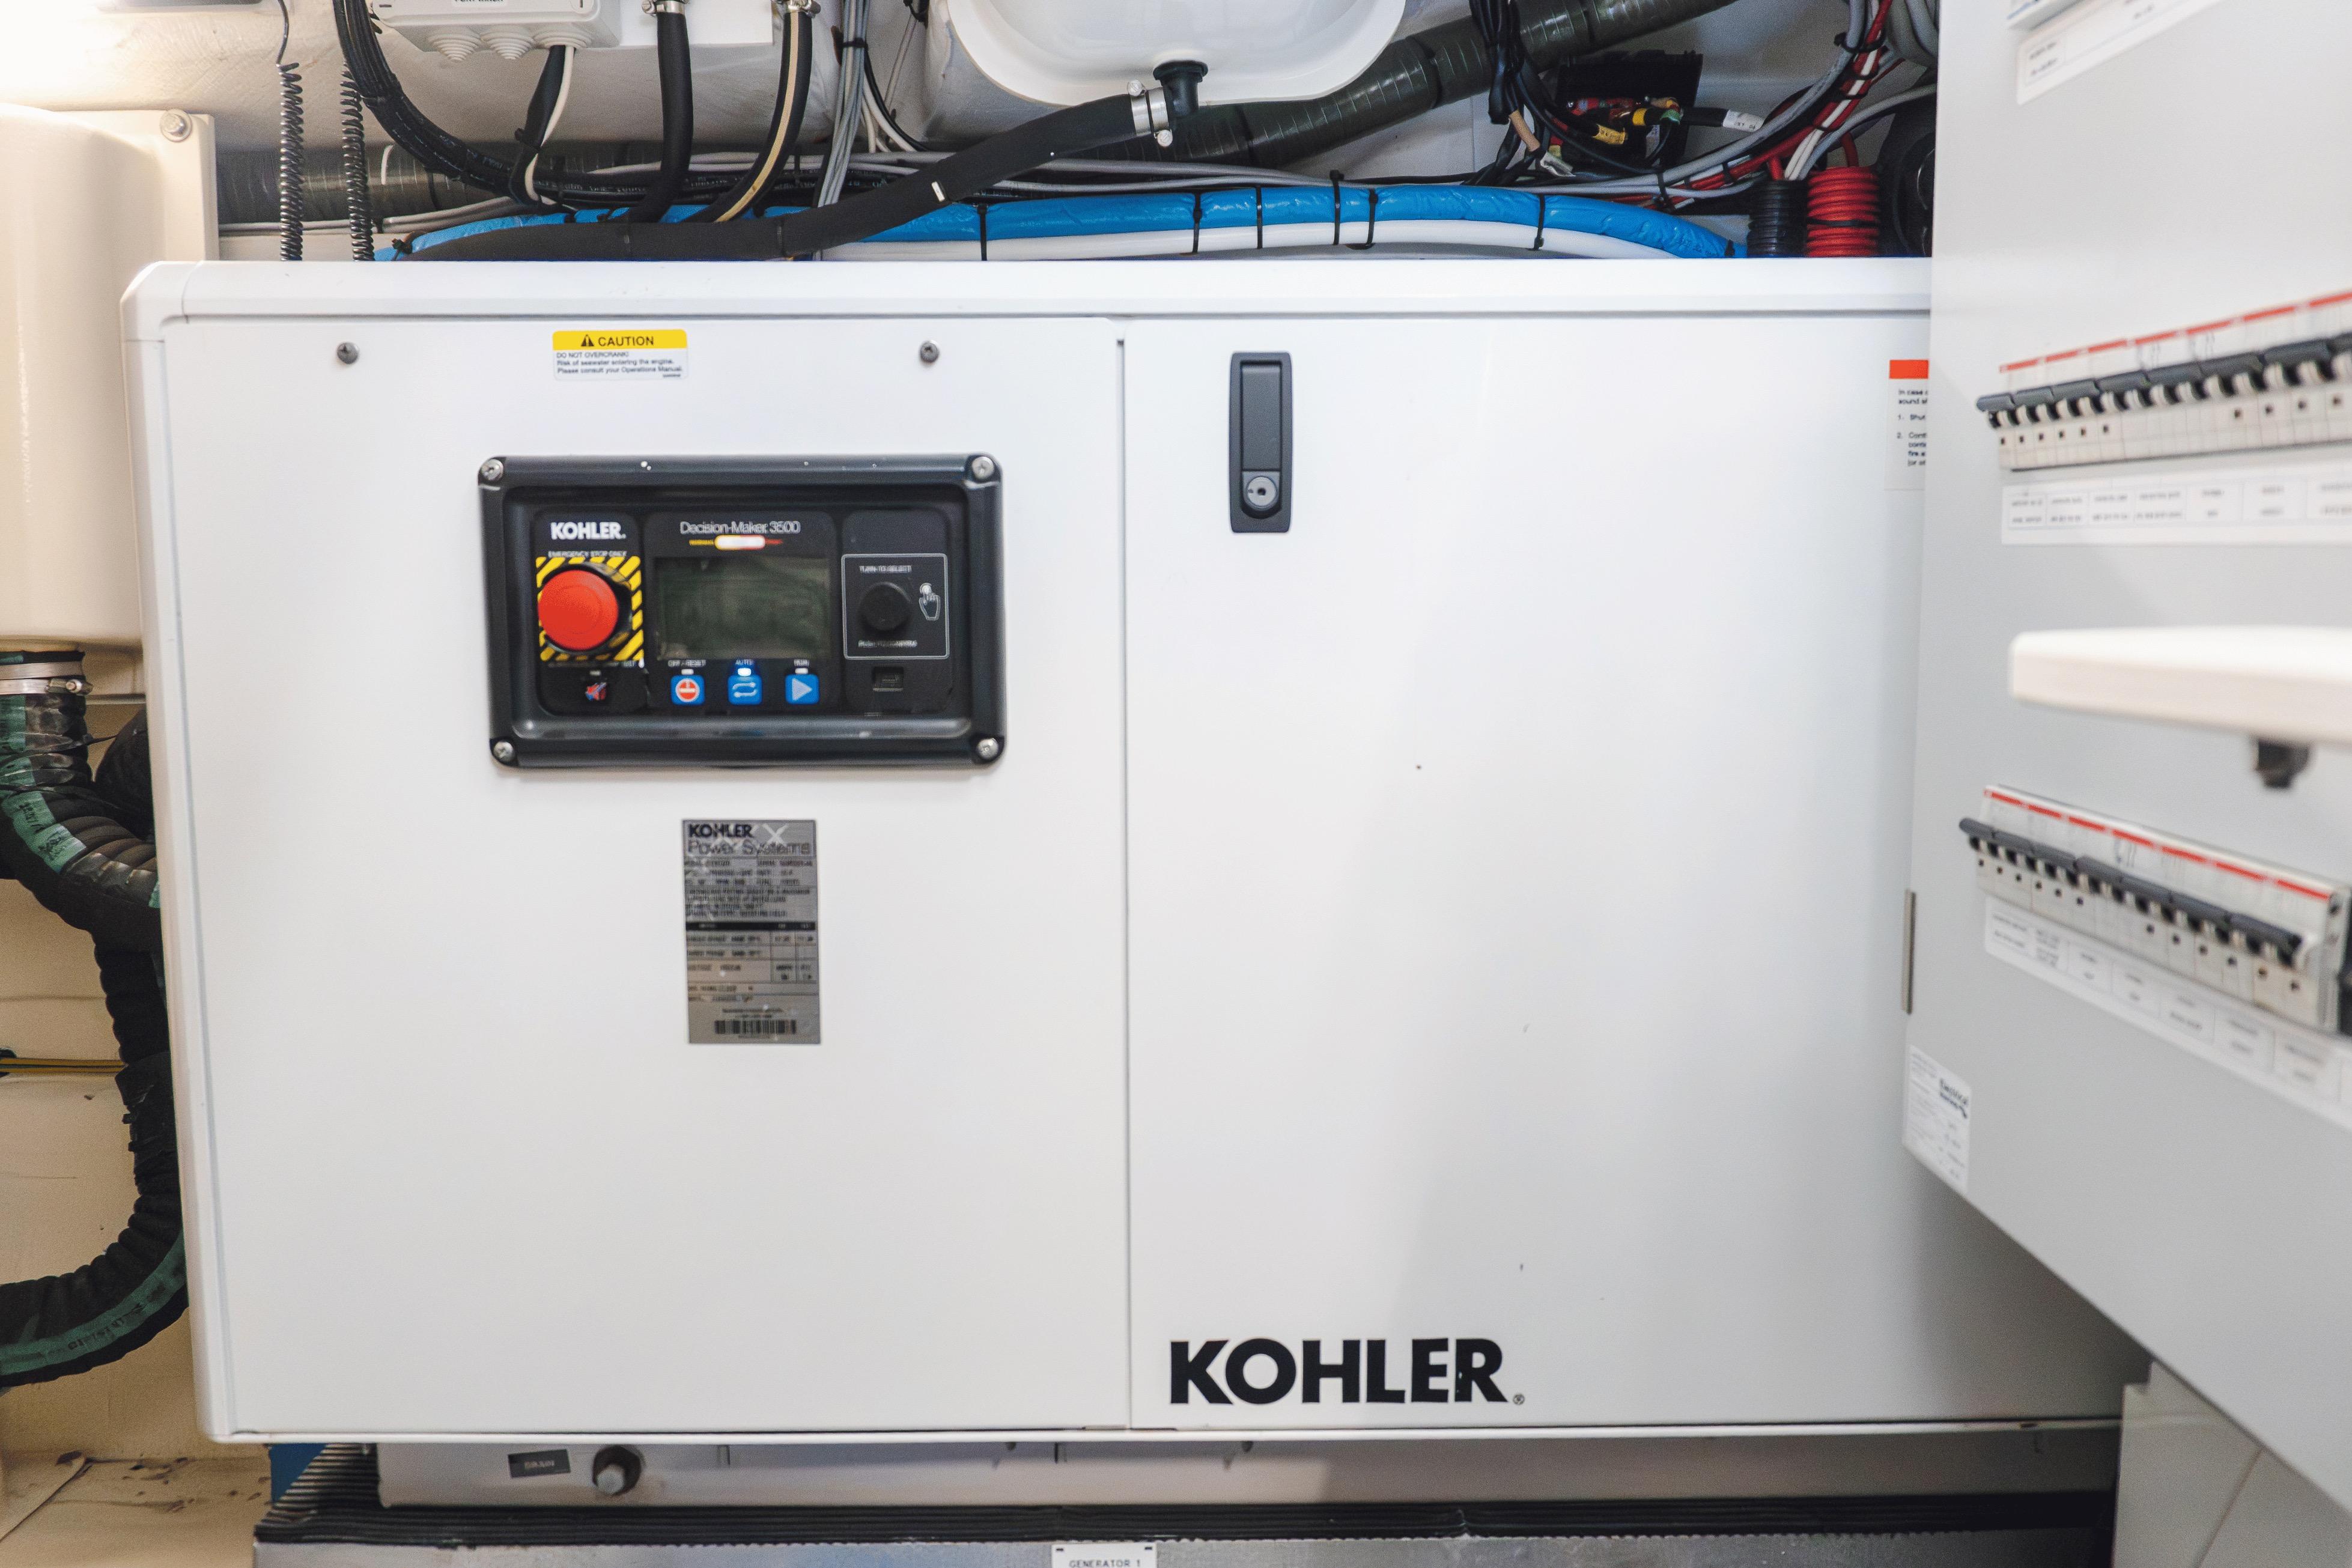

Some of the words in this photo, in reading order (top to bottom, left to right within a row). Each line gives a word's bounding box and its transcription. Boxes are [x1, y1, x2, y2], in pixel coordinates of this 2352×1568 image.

[598, 336, 654, 347] CAUTION
[550, 521, 622, 540] KOHLER
[679, 521, 767, 535] Decision-Maker
[769, 520, 801, 534] 3500
[688, 824, 754, 838] KOHLER
[1170, 1338, 1509, 1405] KOHLER
[1069, 1560, 1131, 1568] GENERATOR
